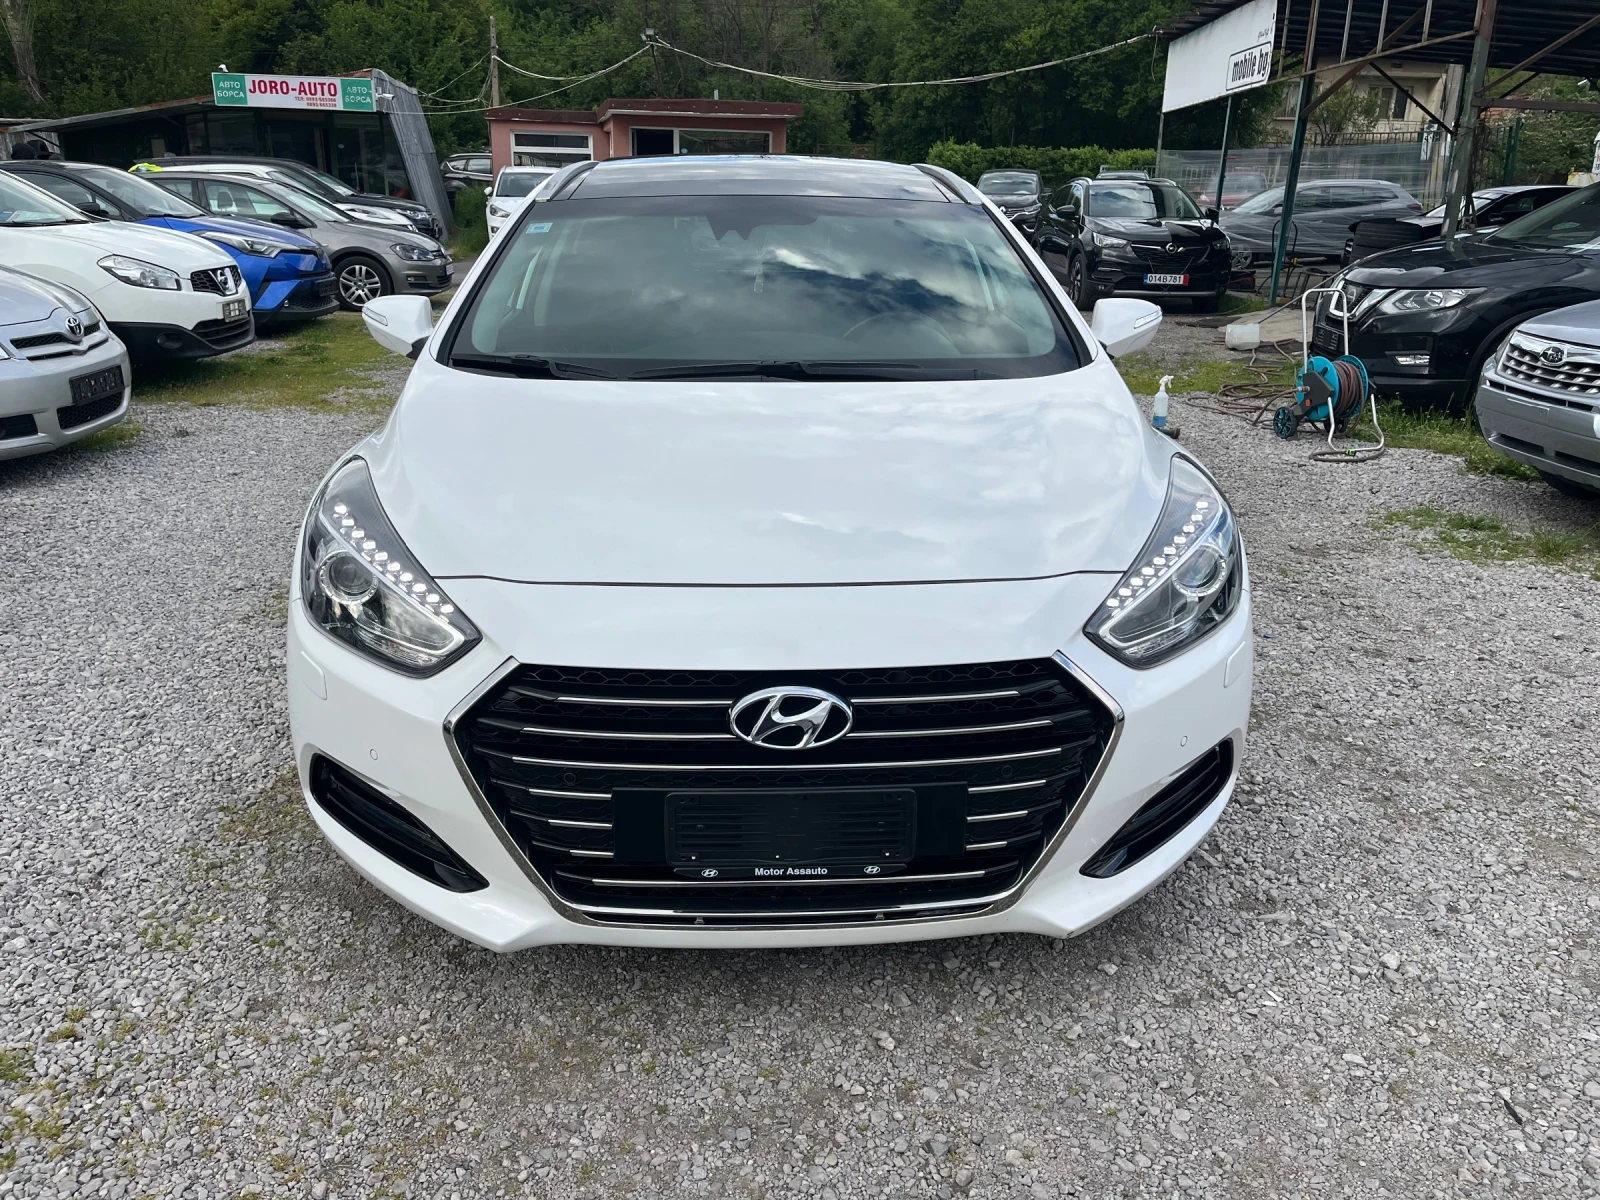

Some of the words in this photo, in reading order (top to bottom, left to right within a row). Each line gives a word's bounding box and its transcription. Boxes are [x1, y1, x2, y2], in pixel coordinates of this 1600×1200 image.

[219, 81, 241, 89] АВТО
[248, 79, 338, 97] JORO-AUTO
[217, 90, 245, 98] БОРСА
[344, 95, 372, 103] БОРСА
[1148, 274, 1182, 284] 014B781
[754, 867, 785, 876] Motor
[786, 867, 828, 875] Assauto
